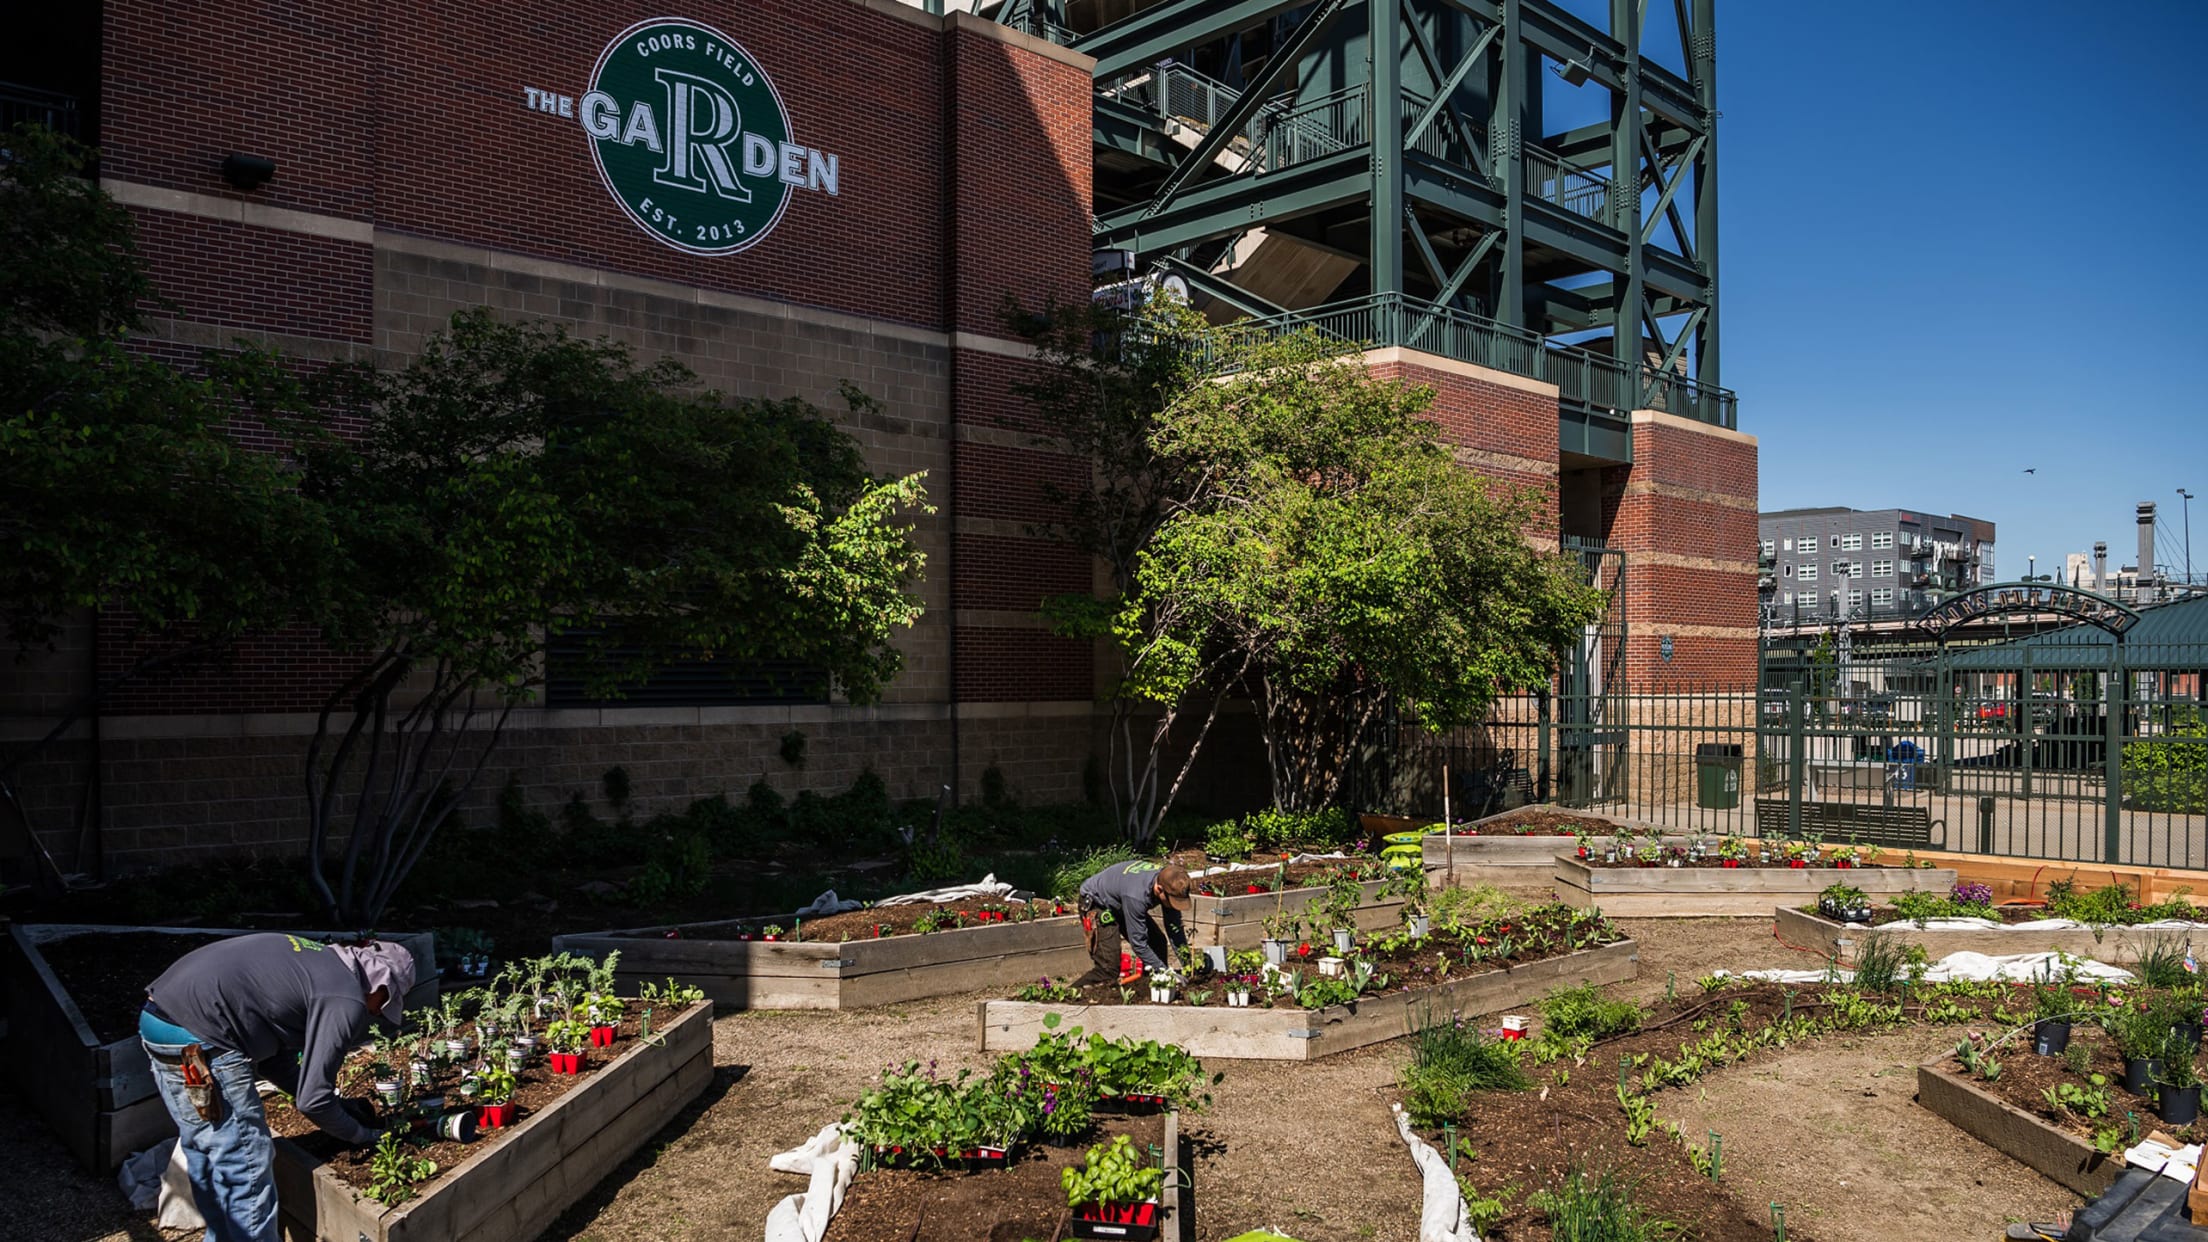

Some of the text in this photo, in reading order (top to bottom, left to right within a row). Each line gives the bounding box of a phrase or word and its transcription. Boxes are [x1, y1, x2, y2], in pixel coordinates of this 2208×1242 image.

[637, 33, 755, 87] COORS FIELD
[523, 67, 839, 204] THE GARDEN
[639, 197, 745, 241] EST. 2013
